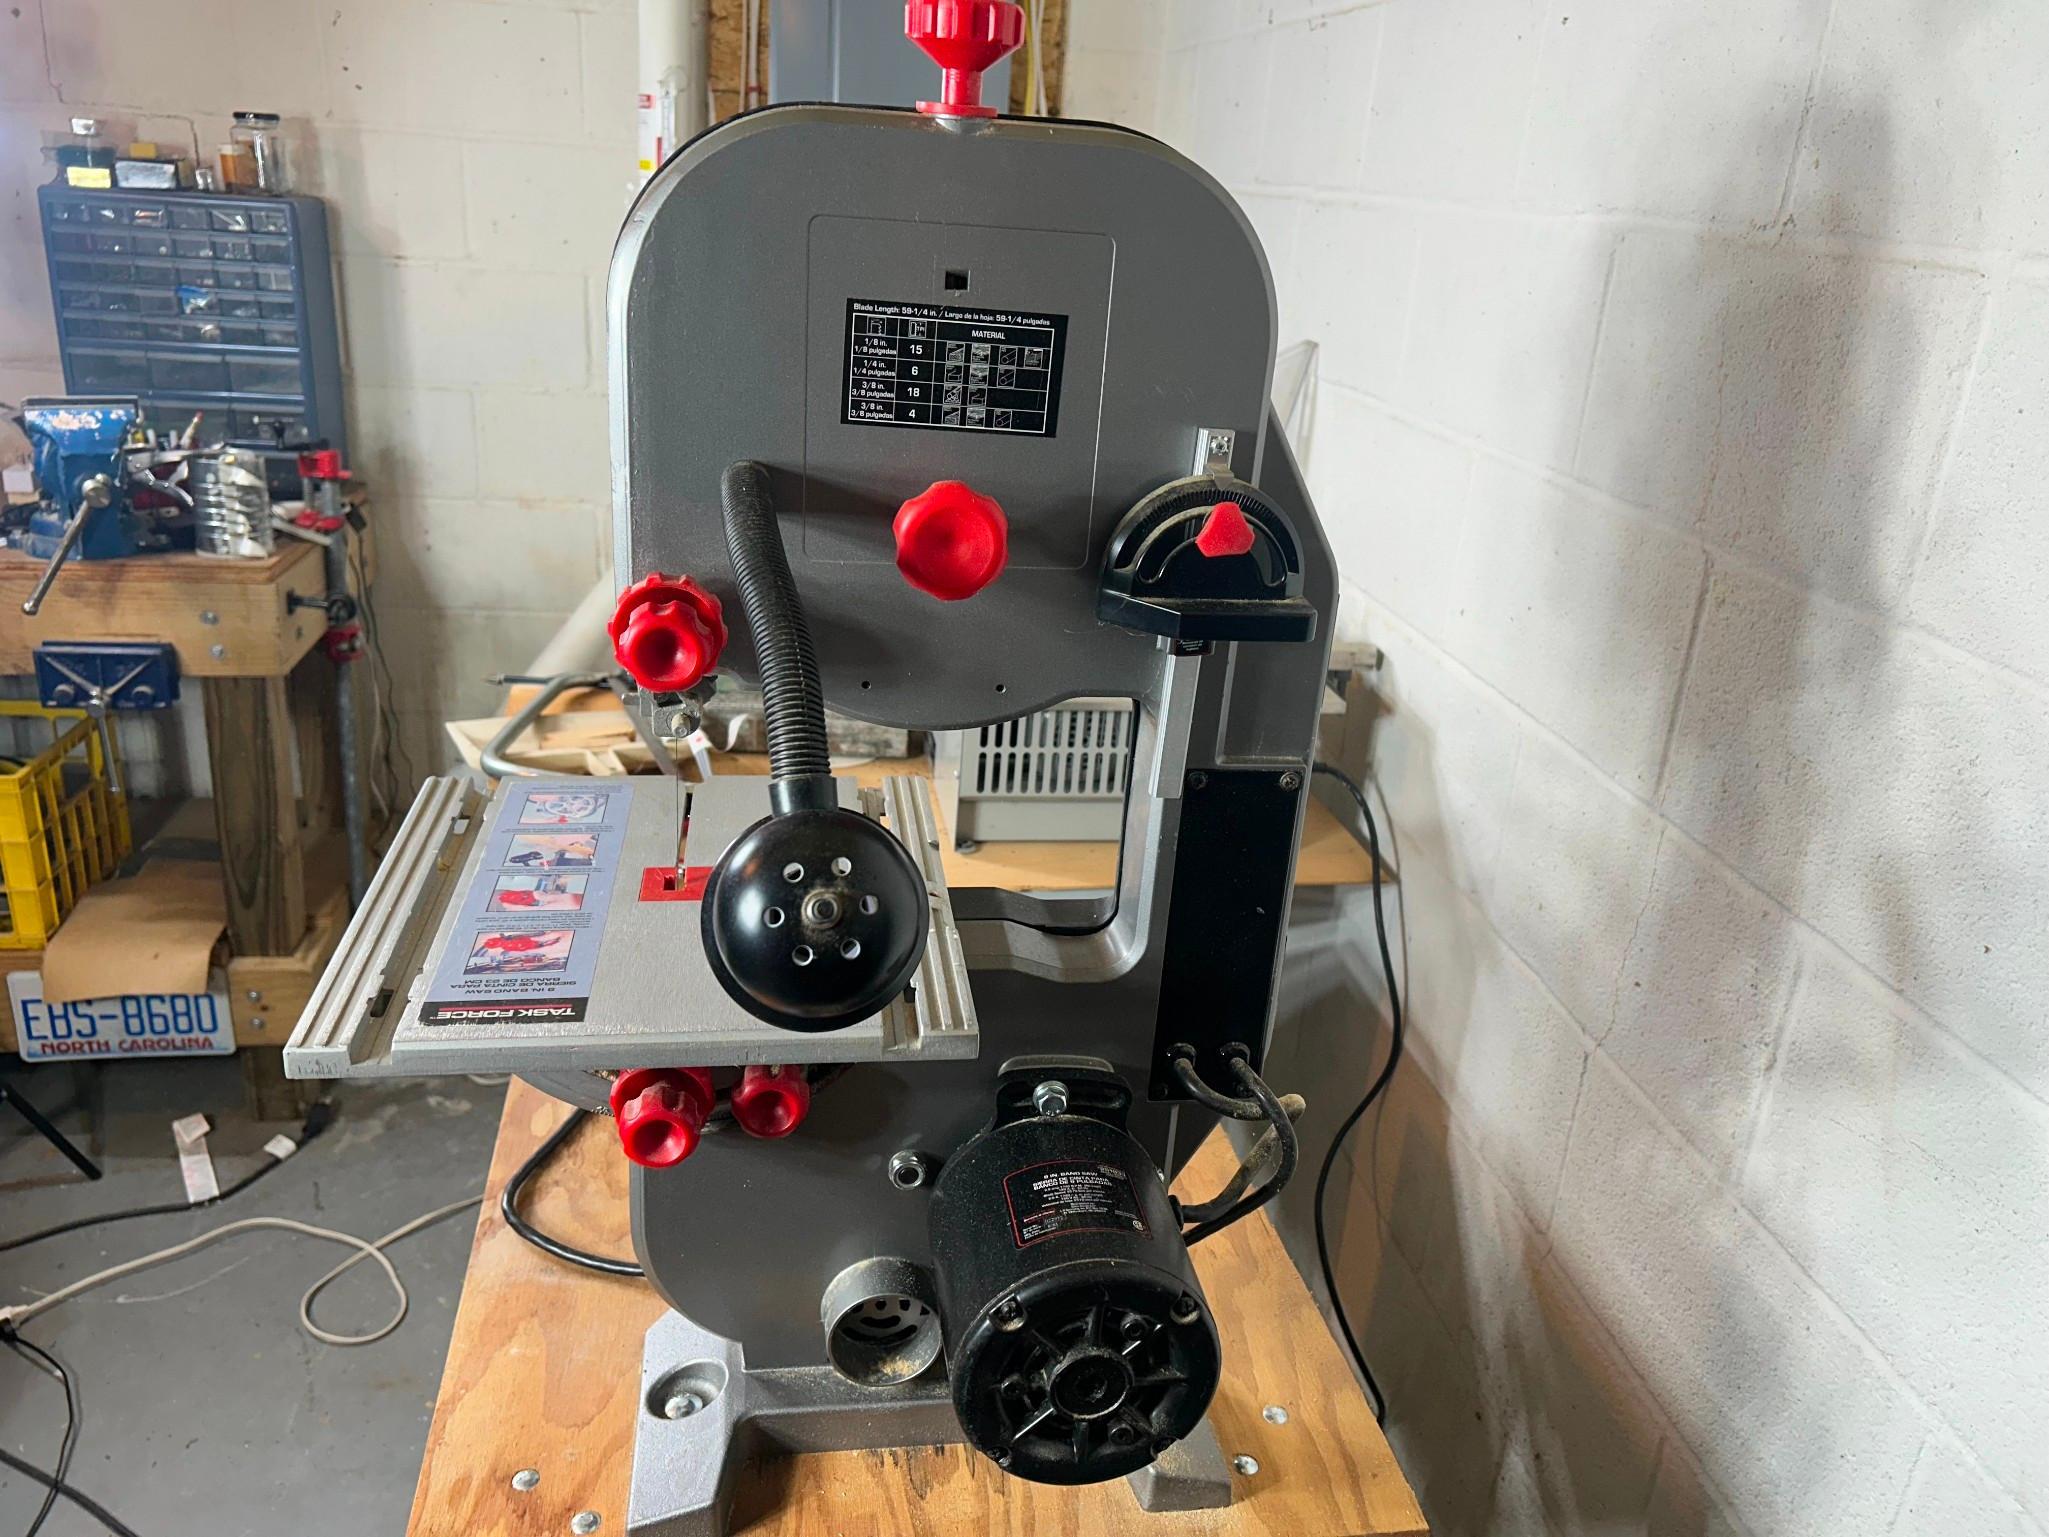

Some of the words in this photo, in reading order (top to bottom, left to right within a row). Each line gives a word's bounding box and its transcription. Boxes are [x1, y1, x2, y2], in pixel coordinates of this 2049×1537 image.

[853, 303, 873, 311] Blade
[874, 305, 900, 314] Length:
[901, 307, 928, 316] 59-1/4
[929, 309, 937, 317] in.
[944, 311, 963, 320] Largo
[980, 313, 995, 322] hoja:
[996, 314, 1022, 324] 59-1/4
[1022, 317, 1050, 326] pulgadas
[971, 330, 1006, 339] MATERIAL
[865, 338, 878, 346] 1/8
[854, 345, 868, 354] 1/8
[868, 347, 896, 355] pulgadas
[909, 344, 923, 354] 15
[863, 360, 877, 368] 1/4
[853, 367, 867, 375] 1/4
[867, 369, 895, 377] pulgadas
[911, 366, 919, 375] 6
[862, 381, 876, 390] 3/8
[877, 382, 885, 390] in.
[851, 388, 866, 396] 3/8
[866, 390, 894, 398] pulgadas
[907, 387, 920, 397] 18
[860, 402, 875, 410] 3/8
[876, 403, 884, 411] in.
[851, 409, 865, 417] 3/8
[865, 411, 893, 419] pulgadas
[908, 409, 916, 418] 4
[437, 1009, 514, 1018] FORCE
[518, 1007, 576, 1017] TASK
[40, 1040, 110, 1055] NORTH
[118, 1036, 214, 1051] CAROLINA
